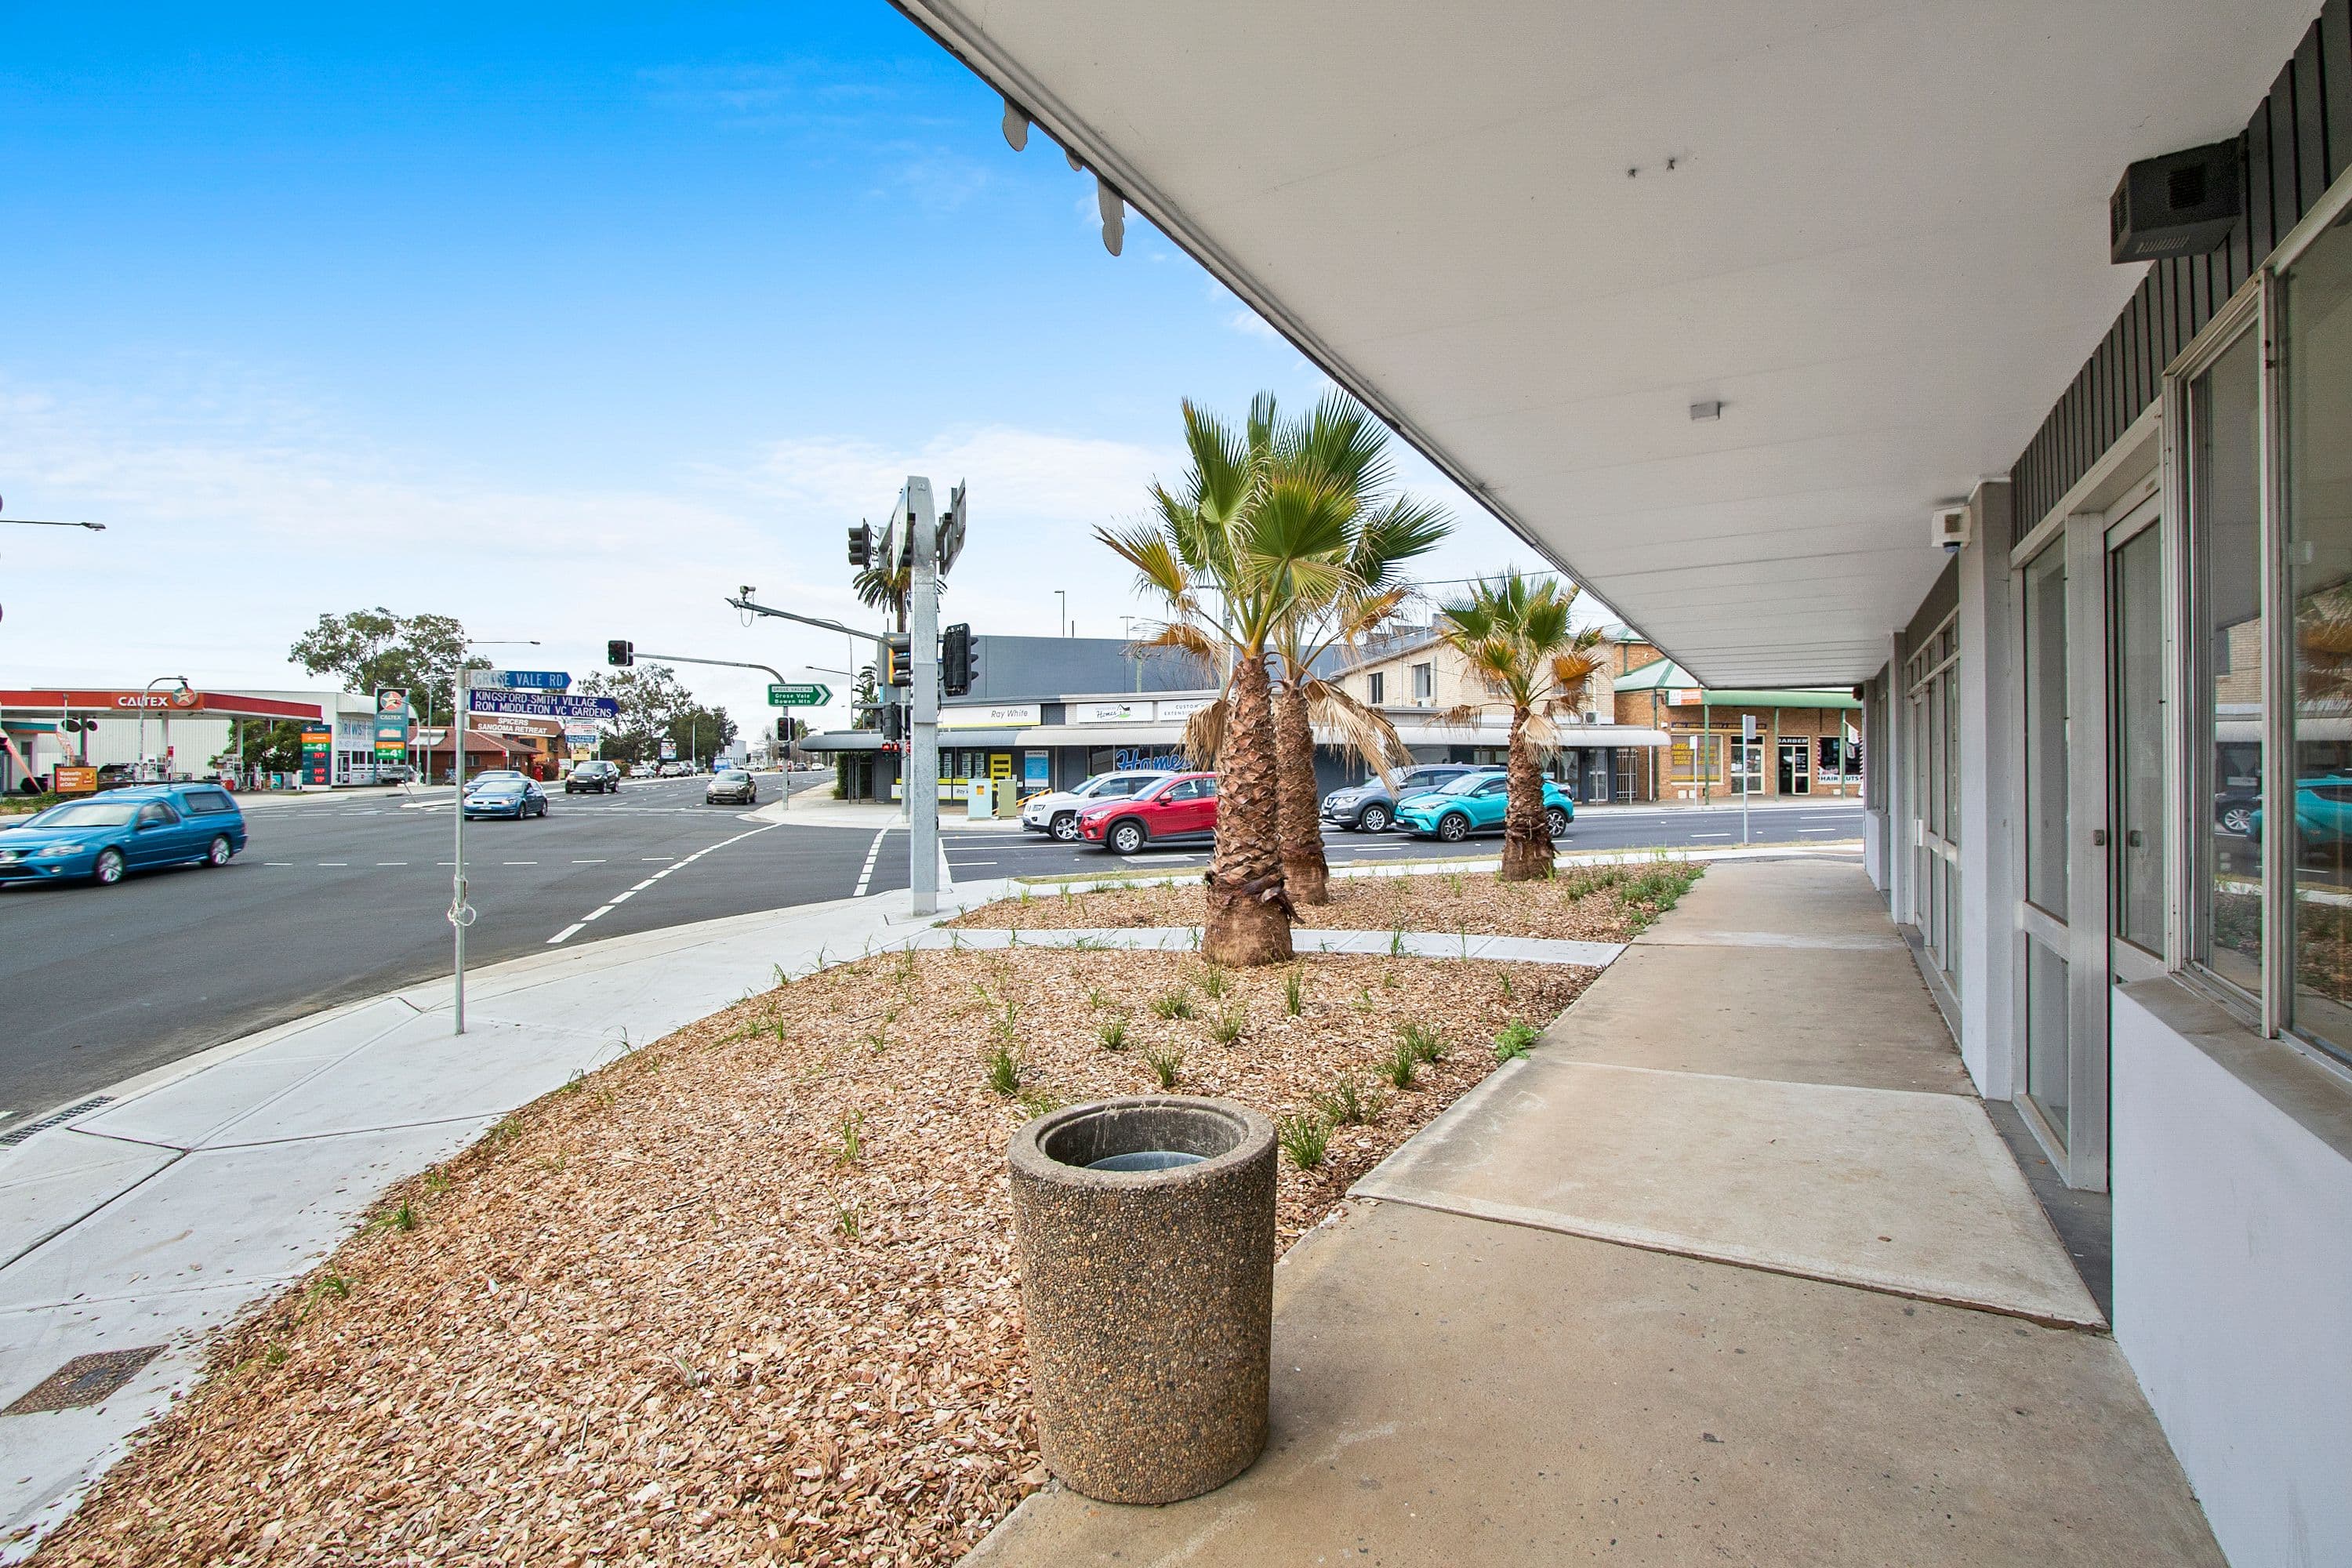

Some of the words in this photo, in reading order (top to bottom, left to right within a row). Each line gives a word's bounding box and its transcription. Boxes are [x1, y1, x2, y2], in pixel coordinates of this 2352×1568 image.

[475, 672, 510, 686] GROSE
[517, 673, 543, 686] VALE
[549, 674, 563, 686] RD
[118, 696, 169, 707] CALTEX
[475, 691, 557, 705] KINGSFORD-SMITH
[562, 696, 597, 708] VILLAGE
[475, 702, 495, 711] RON
[499, 702, 550, 714] MIDDLETON
[555, 706, 567, 716] VC
[572, 707, 612, 718] GARDENS
[991, 710, 1005, 720] Ray
[498, 717, 529, 726] SPICERS
[477, 723, 514, 731] SANGOMA
[514, 725, 547, 735] RETREAT
